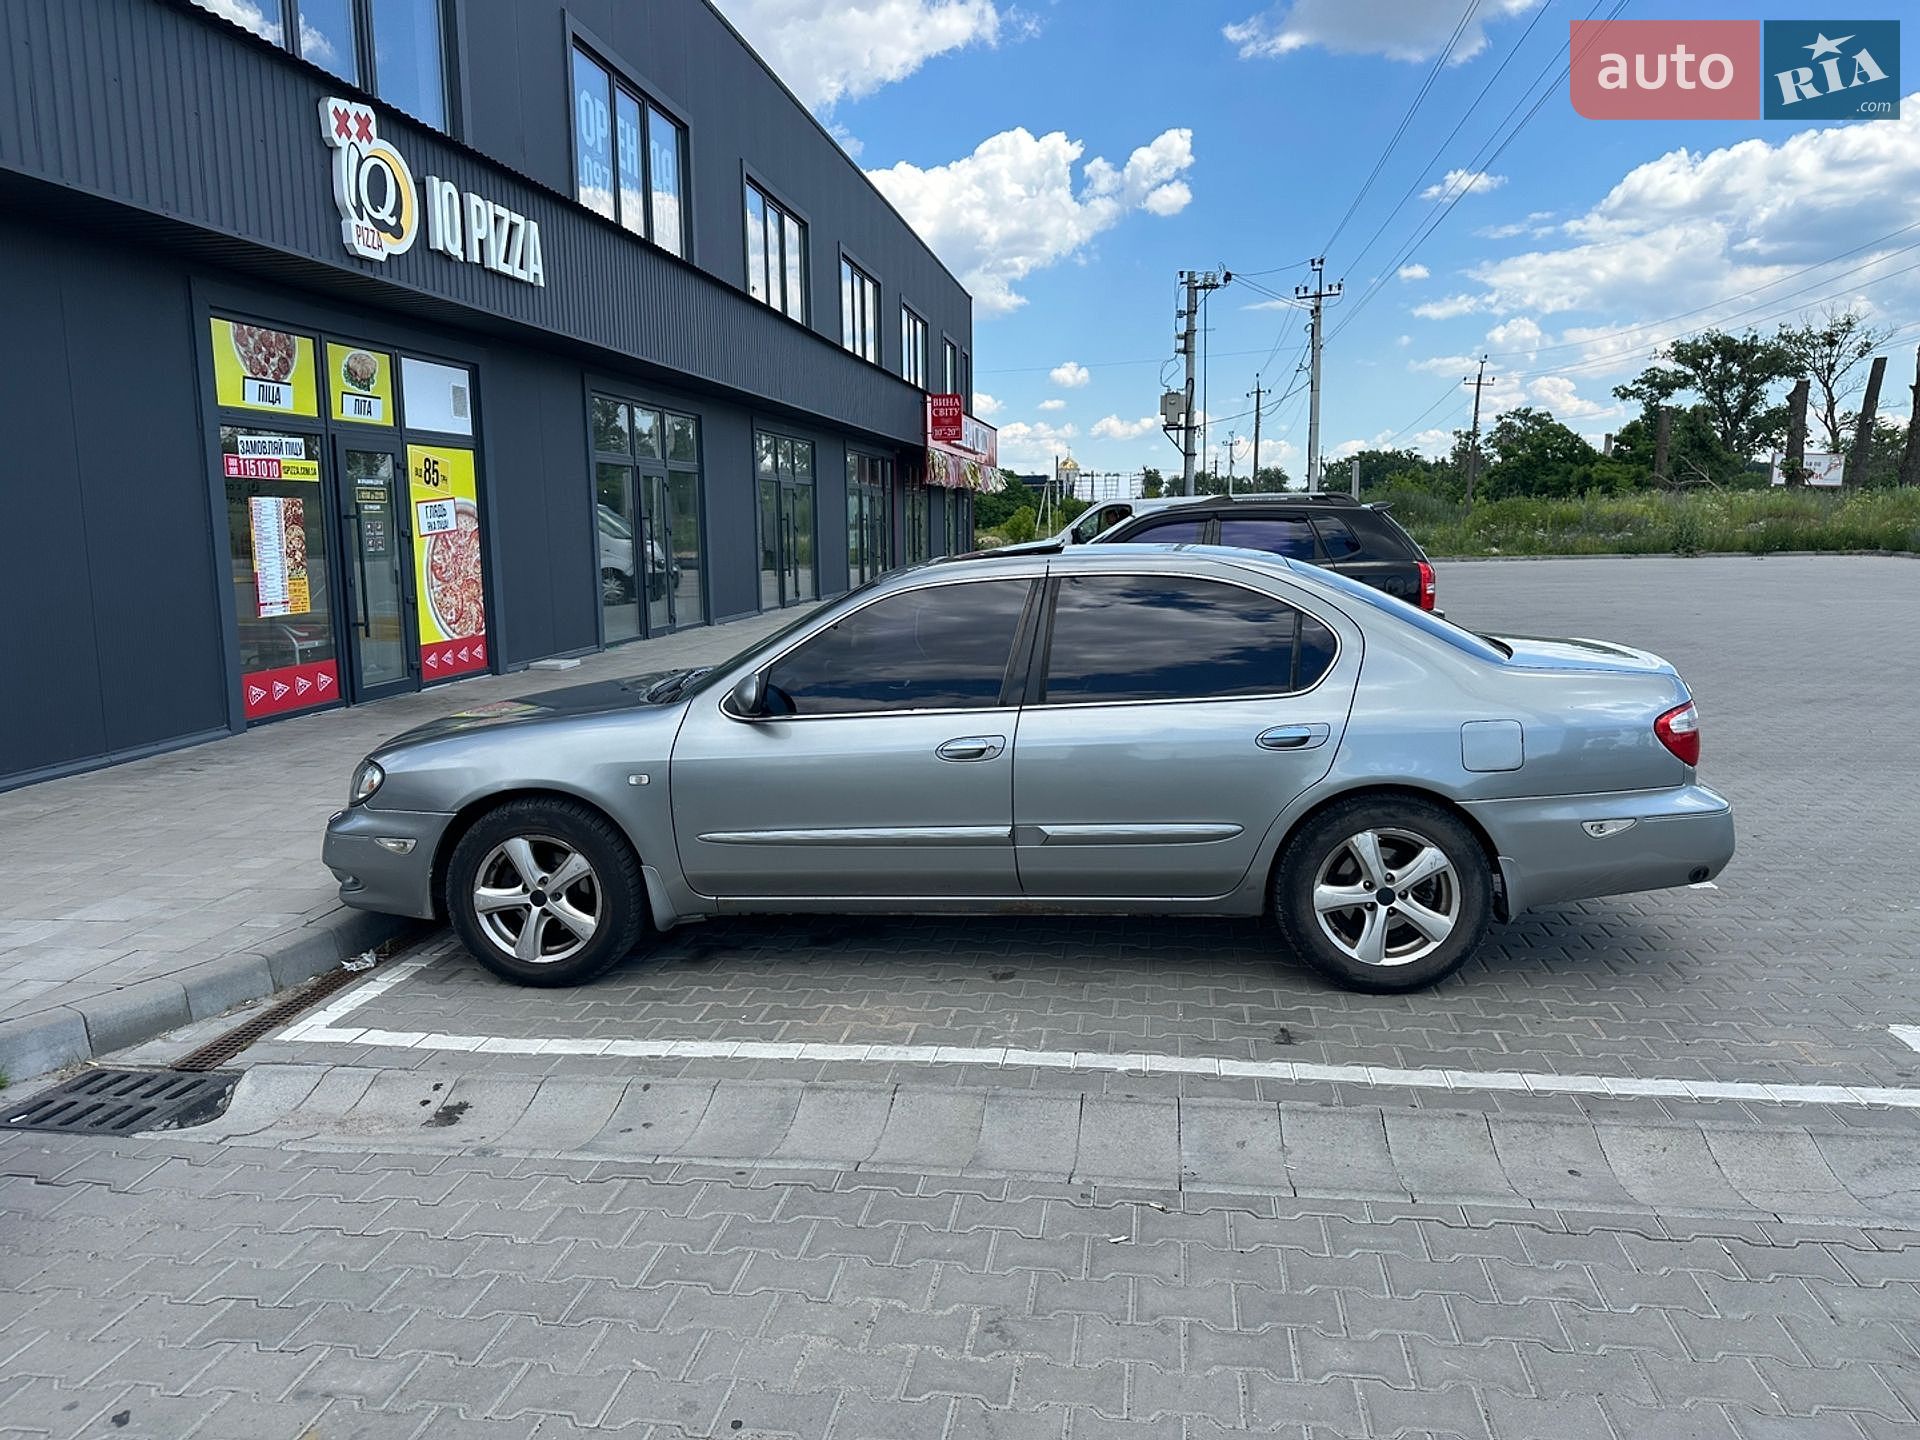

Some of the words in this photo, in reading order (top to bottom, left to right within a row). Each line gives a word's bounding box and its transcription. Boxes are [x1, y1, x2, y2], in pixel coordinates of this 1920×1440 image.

[347, 141, 398, 227] IQ
[355, 223, 384, 254] PIZZA
[425, 175, 464, 263] IQ
[463, 191, 545, 288] PIZZA
[257, 383, 282, 406] ПІЦА
[933, 398, 960, 406] ВИНА
[353, 398, 373, 418] ПІТА
[932, 407, 960, 417] СВІТУ
[239, 438, 284, 456] ЗАМОВЛЯЙ
[239, 458, 279, 478] 1151010
[424, 457, 439, 487] 85
